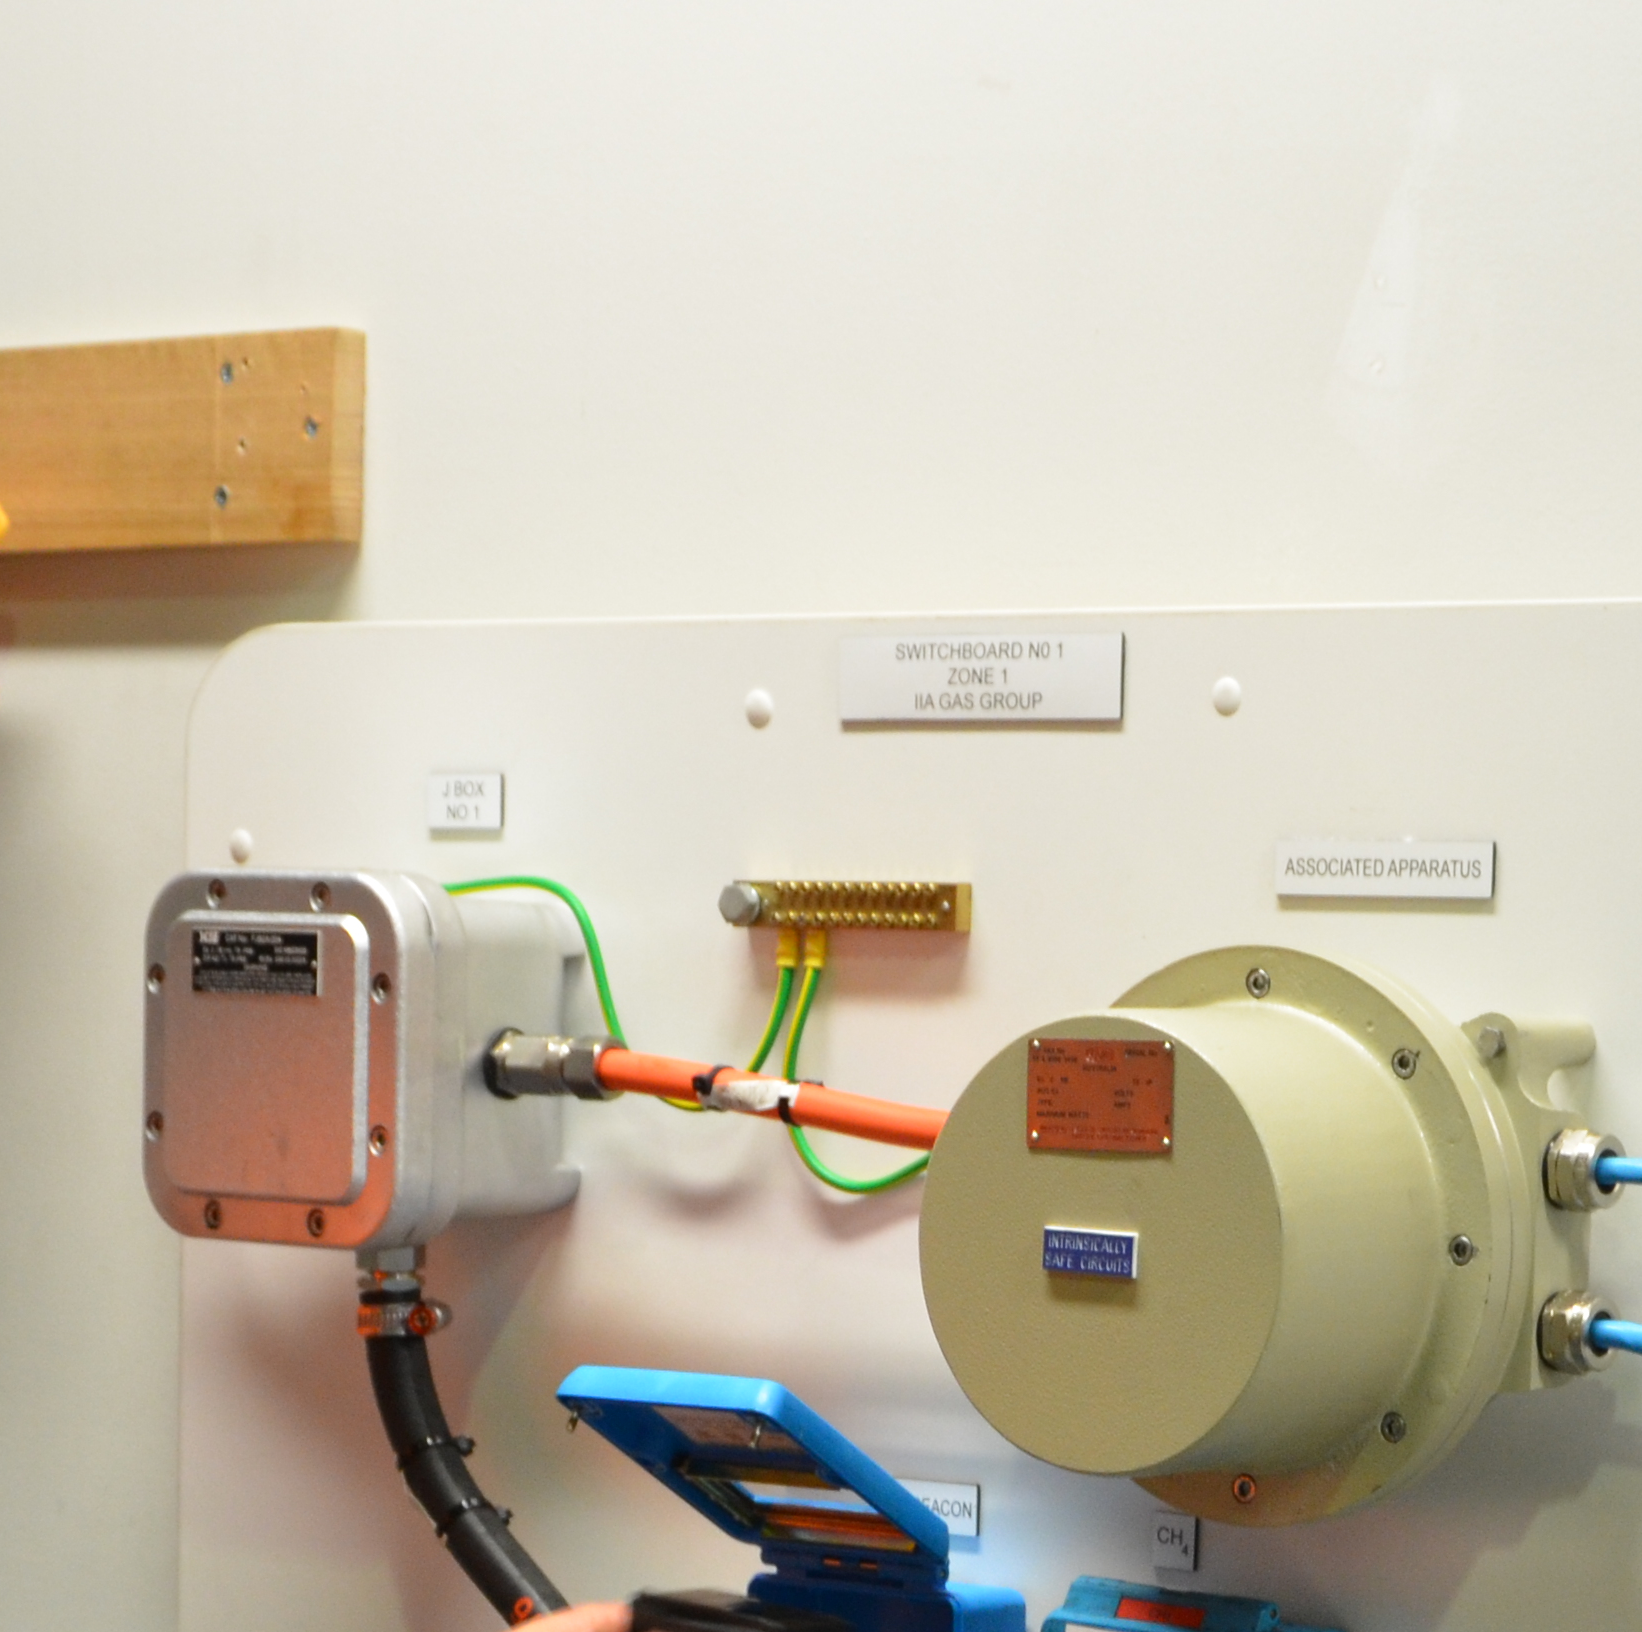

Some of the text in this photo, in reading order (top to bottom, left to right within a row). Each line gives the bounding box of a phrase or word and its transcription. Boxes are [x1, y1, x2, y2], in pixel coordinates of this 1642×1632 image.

[895, 642, 1023, 660] SWITCHBOARD
[1057, 641, 1063, 658] 1
[948, 667, 1008, 685] ZONE 1
[915, 692, 1043, 710] IIA GAS GROUP
[442, 780, 485, 798] J BOX
[474, 804, 479, 820] 1
[1284, 857, 1482, 879] ASSOCIATED APPARATUS
[1048, 1233, 1127, 1254] INTRINSICALLY
[1045, 1251, 1131, 1274] SAFE CIRCUITS
[922, 1497, 972, 1518] ACON
